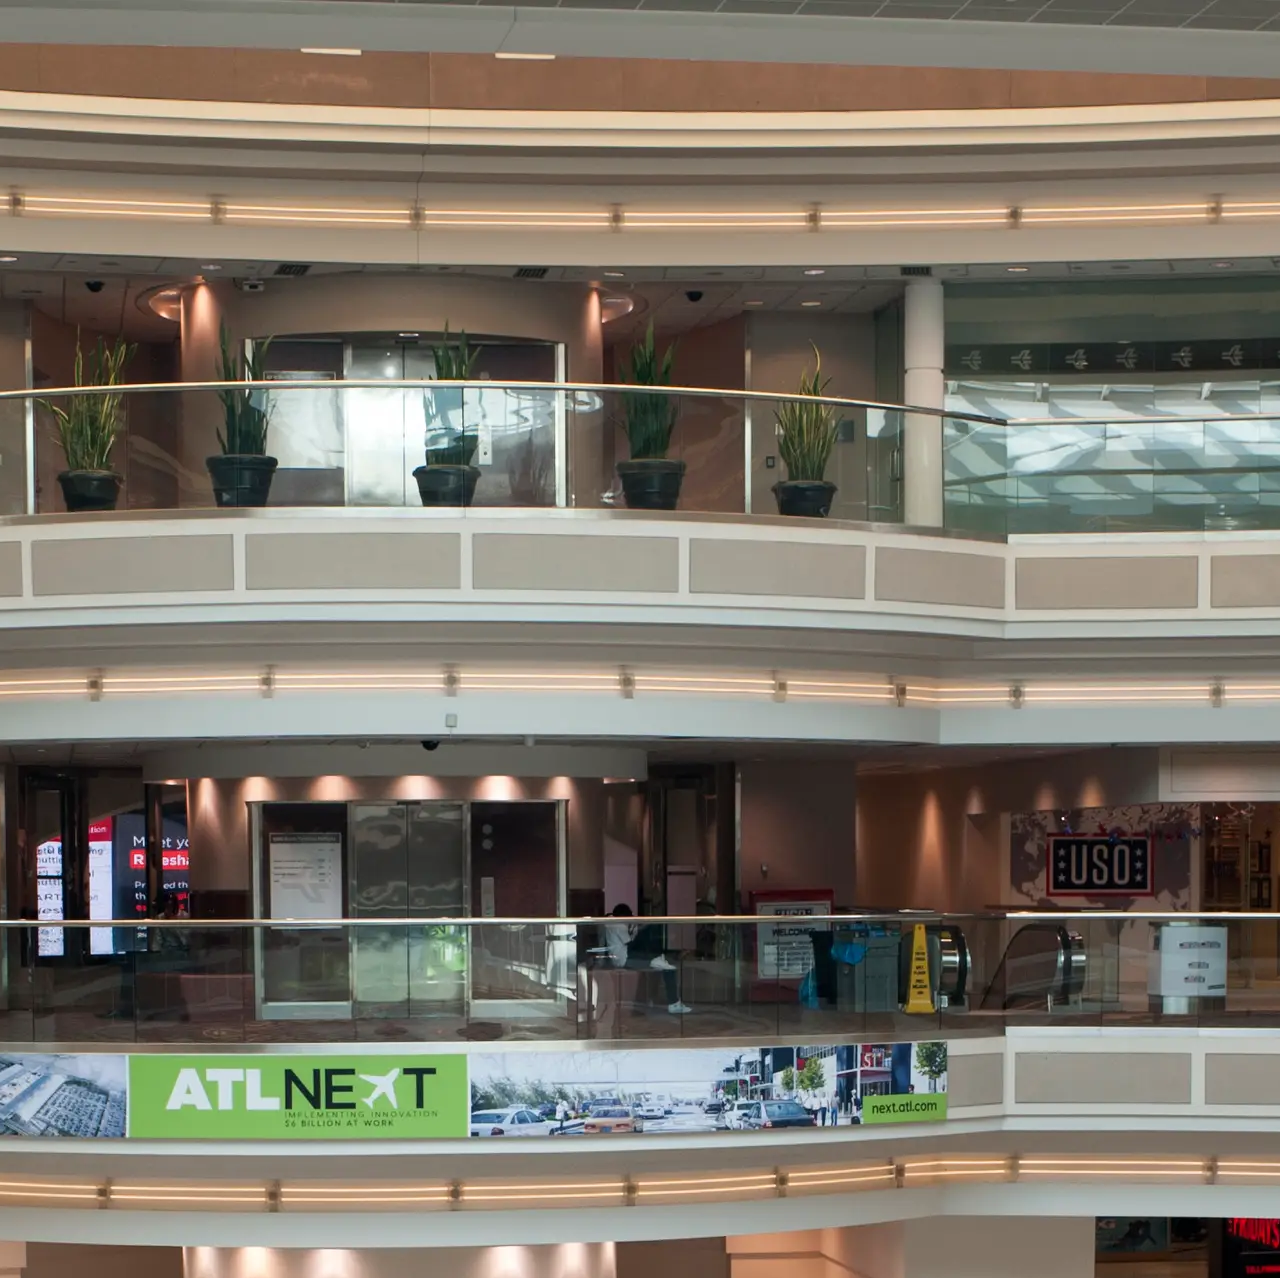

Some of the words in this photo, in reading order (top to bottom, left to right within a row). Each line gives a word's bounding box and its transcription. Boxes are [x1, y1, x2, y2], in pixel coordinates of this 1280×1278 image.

[1070, 844, 1130, 885] USO
[872, 1100, 938, 1114] next.atl.com
[284, 1110, 366, 1118] IMPLEMENTING
[370, 1110, 440, 1118] INNOVATION
[284, 1119, 297, 1128] $6
[301, 1119, 342, 1128] BILLION
[346, 1119, 359, 1127] AT
[363, 1119, 395, 1127] WORK
